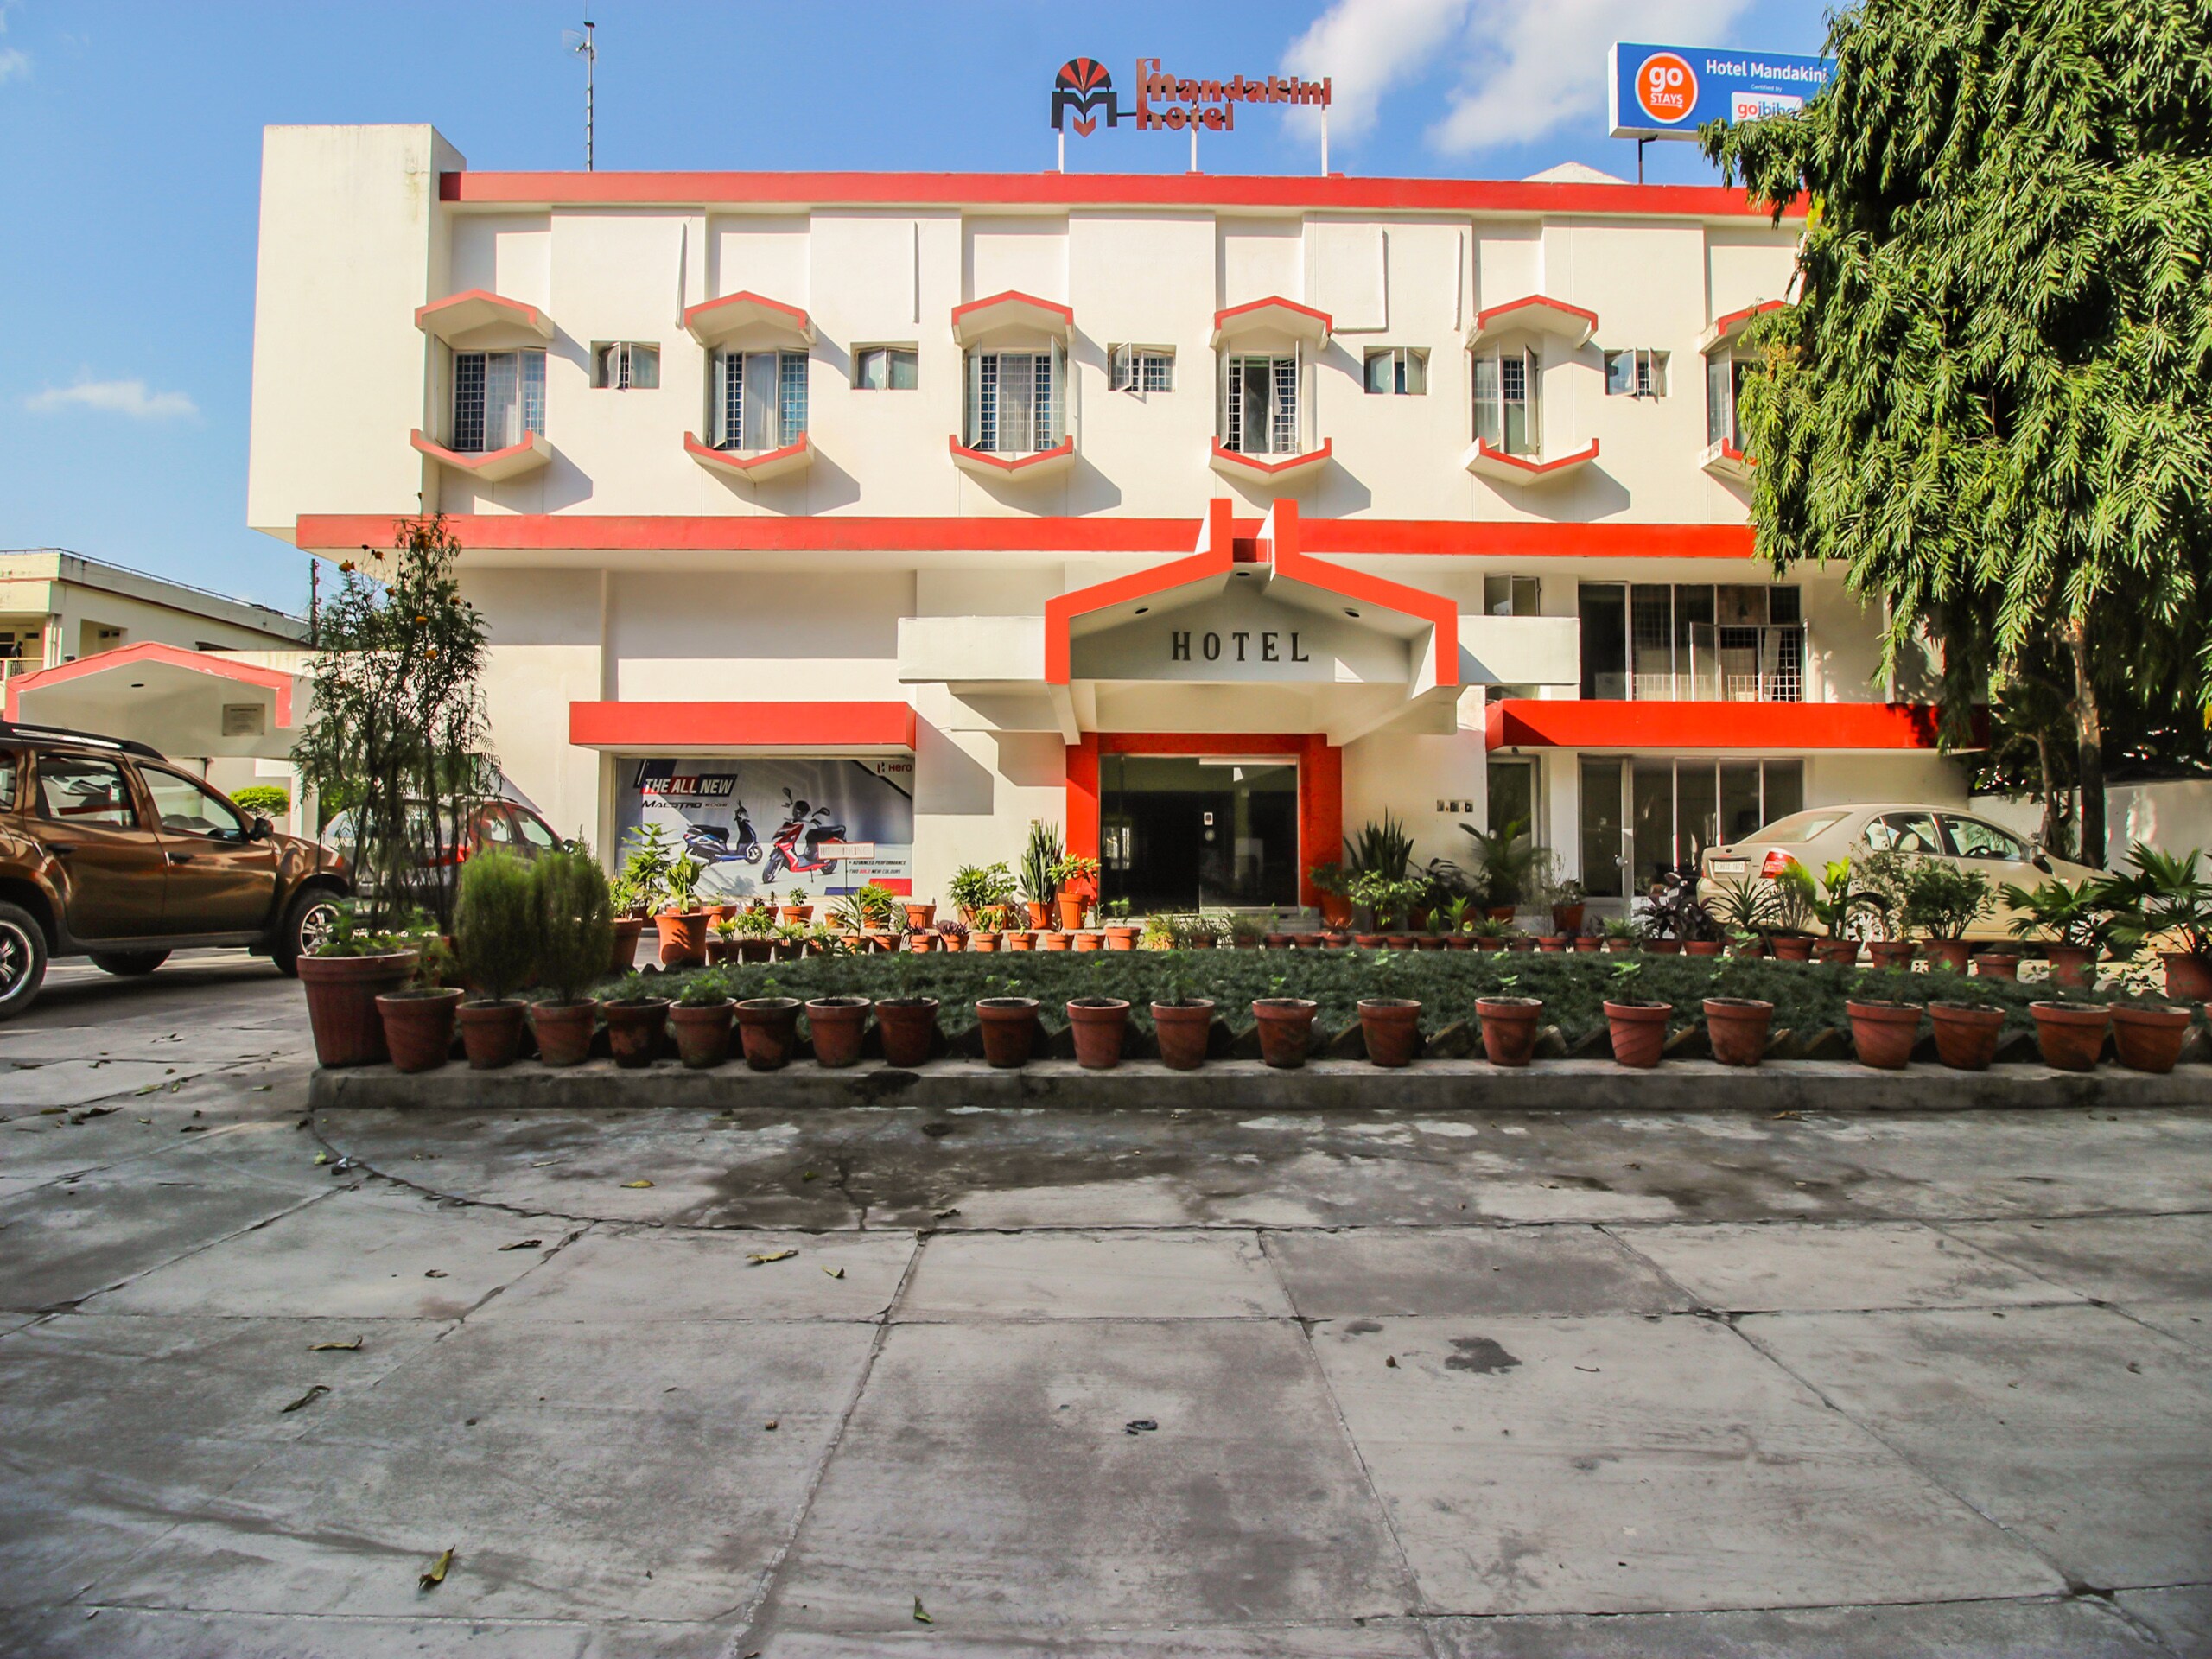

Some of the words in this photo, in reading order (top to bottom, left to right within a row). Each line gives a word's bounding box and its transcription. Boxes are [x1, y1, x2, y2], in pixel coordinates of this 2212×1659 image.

[1649, 66, 1683, 92] go
[1706, 59, 1747, 77] Hotel
[1751, 62, 1827, 83] Mandakini
[1649, 92, 1683, 105] STAYS
[1172, 632, 1309, 662] HOTEL
[888, 764, 912, 772] Hero
[644, 779, 671, 793] THE
[671, 779, 696, 794] ALL
[700, 779, 733, 794] NEW
